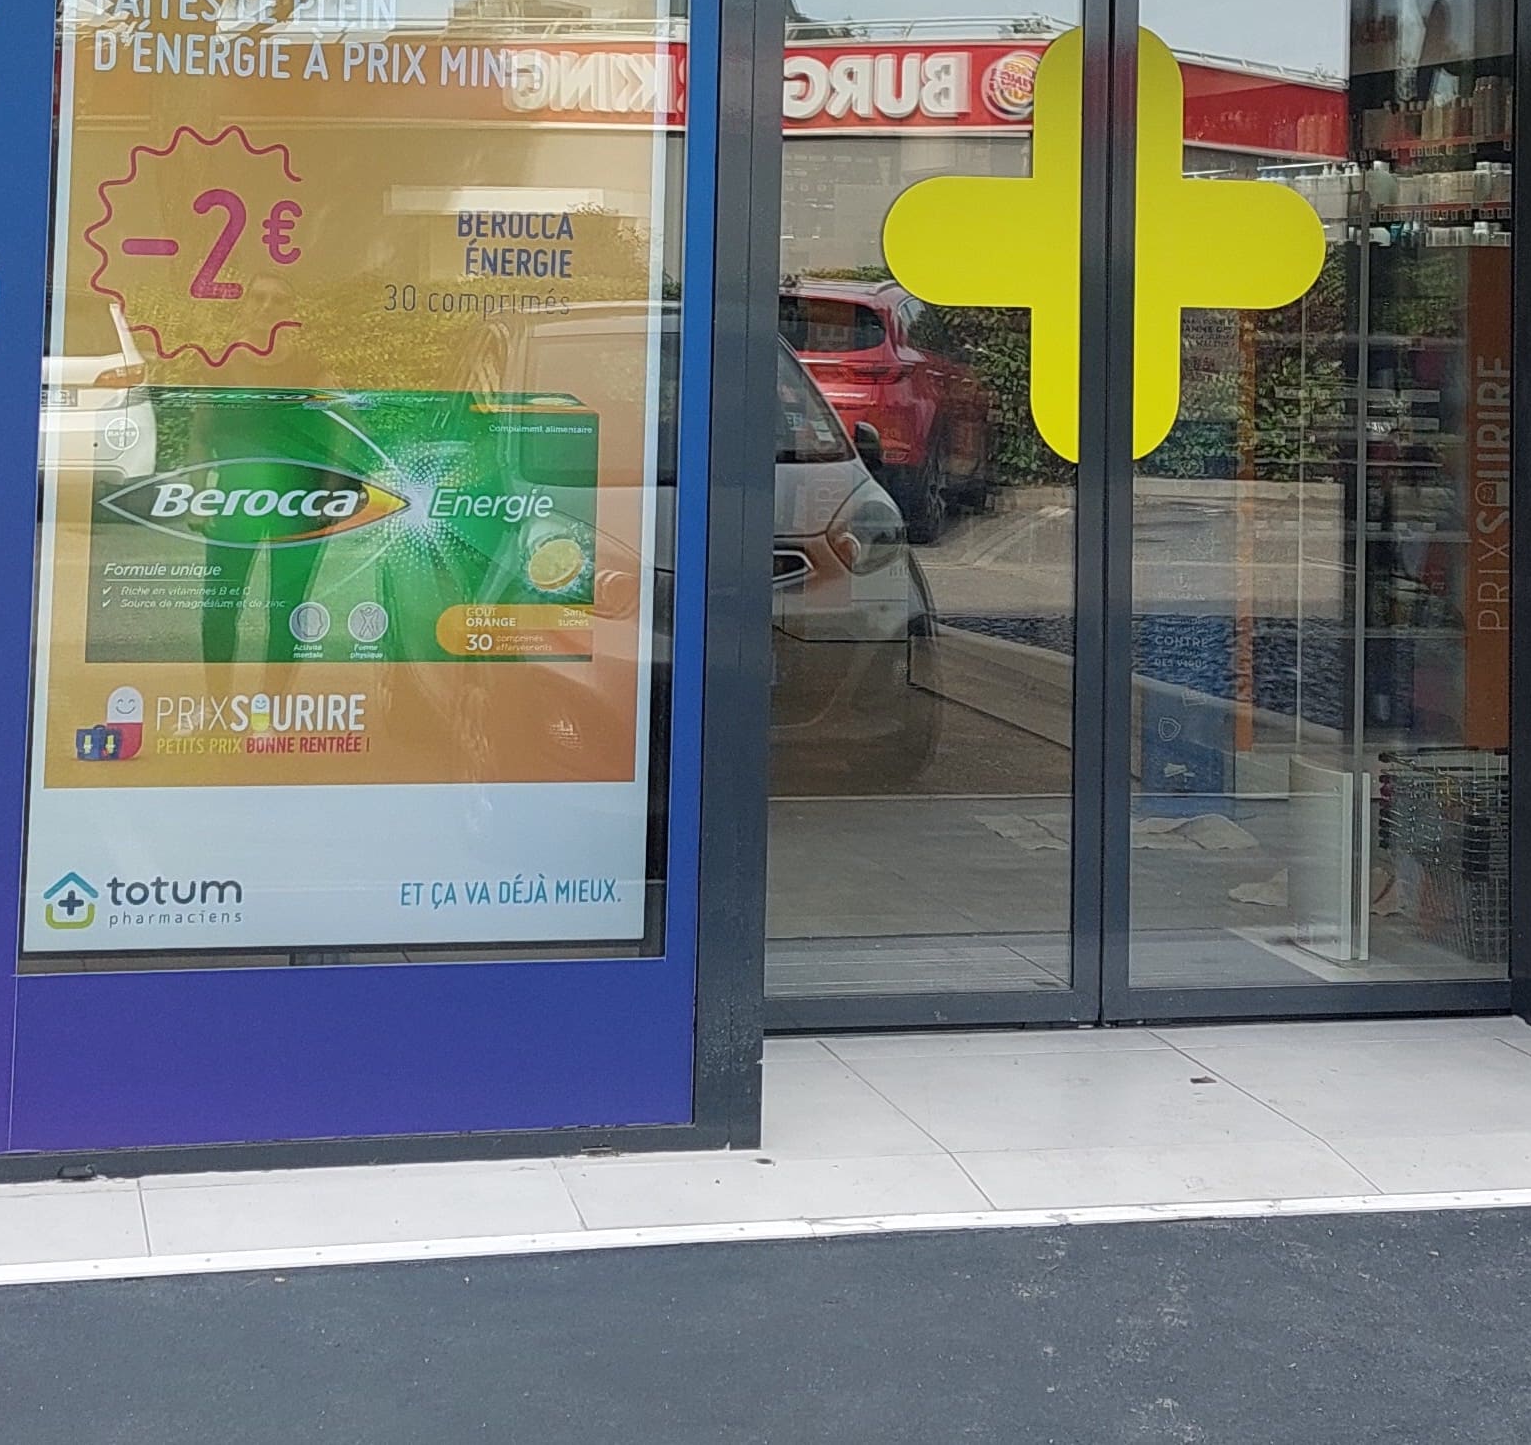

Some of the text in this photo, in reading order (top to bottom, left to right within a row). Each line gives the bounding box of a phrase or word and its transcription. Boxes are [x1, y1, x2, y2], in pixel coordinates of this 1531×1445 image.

[302, 27, 329, 82] À
[343, 41, 426, 85] PRIX
[440, 46, 518, 90] MINI
[458, 210, 574, 240] BEROCCA
[466, 238, 573, 279] ÉNERGIE
[383, 284, 571, 322] 30 comprimés
[150, 482, 554, 523] Berocca Energie
[104, 562, 222, 578] Formule unique
[465, 617, 517, 627] ORANGE
[465, 633, 493, 651] 30
[156, 736, 205, 754] PETITS
[209, 736, 242, 754] PRIX
[245, 735, 295, 754] BONNE
[299, 732, 362, 753] RENTRÉE
[107, 875, 243, 907] totum
[399, 873, 623, 911] ET ÇA VA DÉJÀ MIEUX.
[108, 908, 243, 928] pharmaciens
